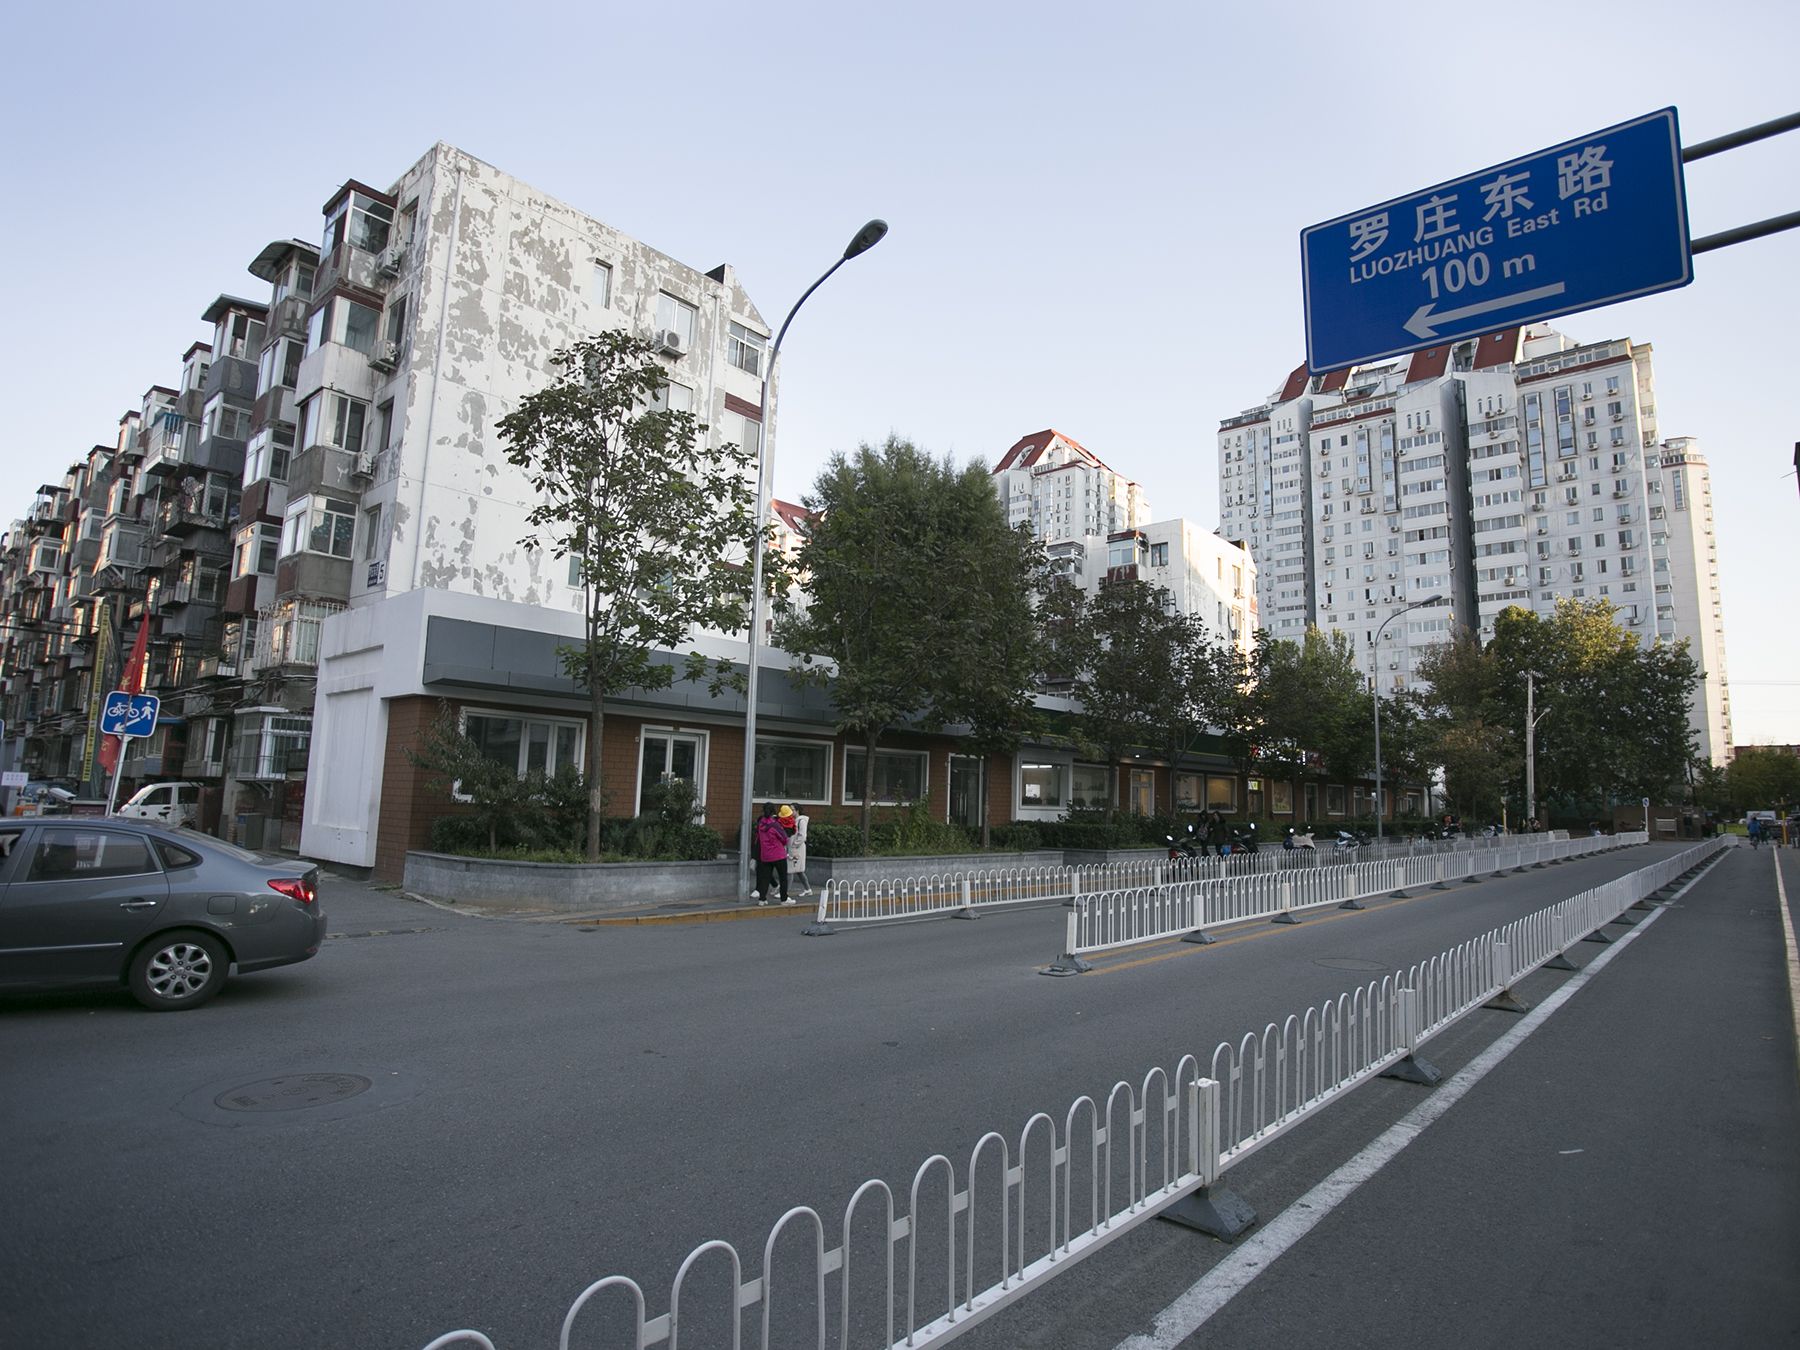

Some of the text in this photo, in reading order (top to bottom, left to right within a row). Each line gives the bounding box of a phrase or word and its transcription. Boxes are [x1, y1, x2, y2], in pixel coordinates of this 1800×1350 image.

[1349, 145, 1614, 263] 罗庄东路
[1350, 191, 1608, 284] LUOZHUANG East Rd
[1421, 251, 1535, 299] 100 m
